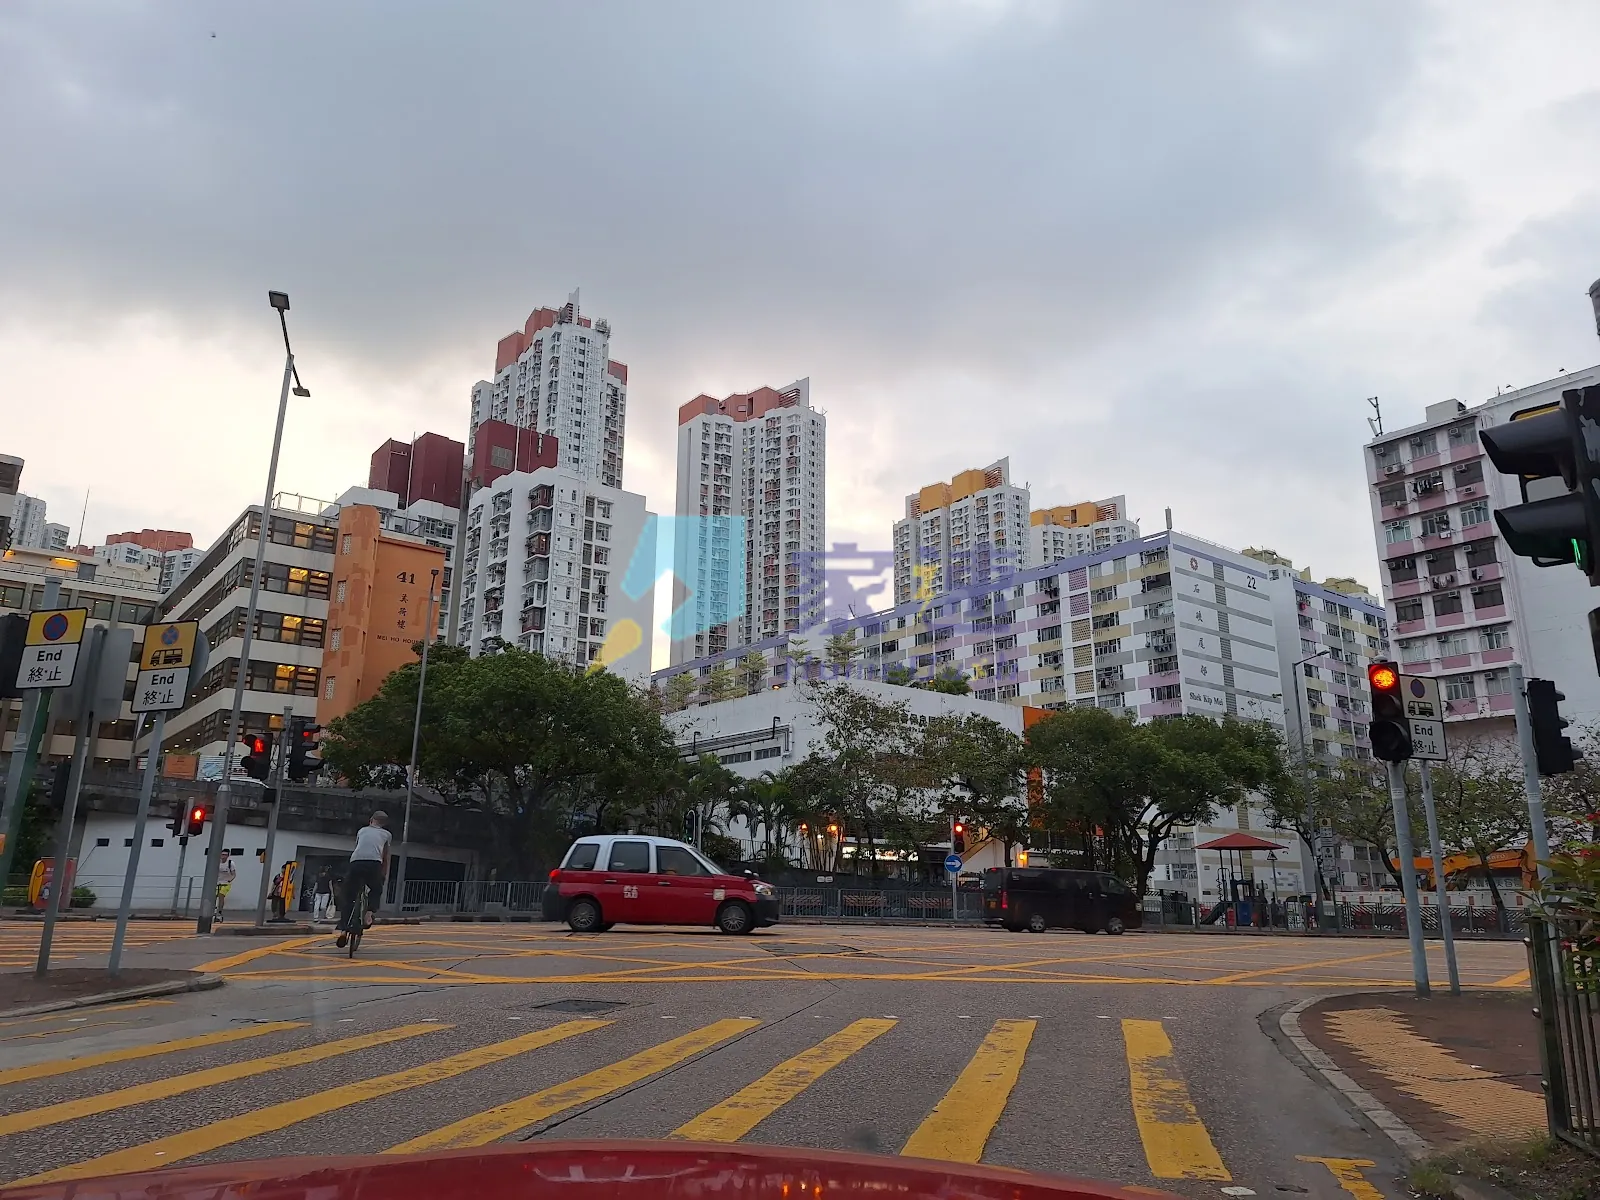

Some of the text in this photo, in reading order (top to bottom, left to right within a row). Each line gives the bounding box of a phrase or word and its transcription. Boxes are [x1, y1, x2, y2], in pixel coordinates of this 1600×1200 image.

[396, 571, 415, 585] 41
[1246, 575, 1257, 590] 22
[37, 649, 63, 662] End
[27, 666, 62, 683] 終止
[151, 672, 175, 686] End
[142, 688, 175, 706] 終止
[1414, 724, 1433, 737] End
[1412, 738, 1440, 755] 終止
